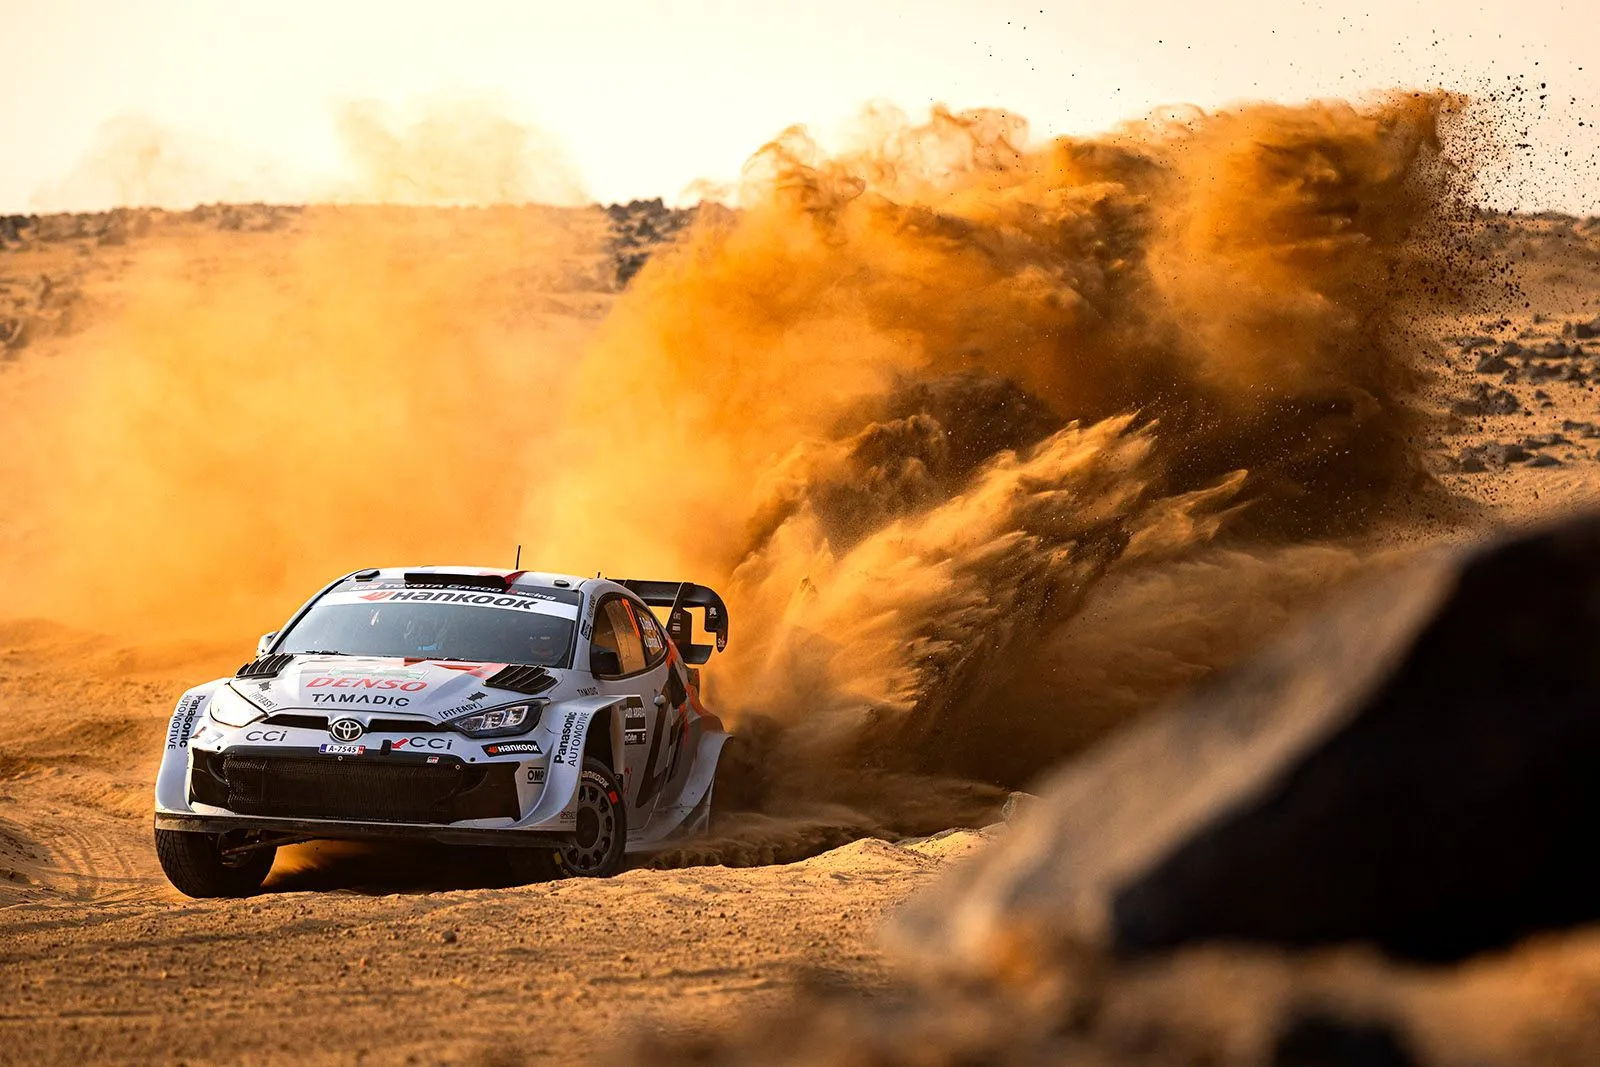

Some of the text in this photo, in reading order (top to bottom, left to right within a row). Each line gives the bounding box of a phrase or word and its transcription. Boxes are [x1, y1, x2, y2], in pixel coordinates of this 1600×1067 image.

[305, 677, 428, 692] DENSO
[311, 693, 410, 707] TAMADIC
[168, 695, 192, 750] AUTOMOTIVE
[179, 695, 206, 748] Panasonic
[553, 711, 577, 764] Panasonic
[328, 744, 356, 753] A-7545
[568, 712, 590, 768] AUTOMOTIVE
[527, 770, 545, 781] OMP
